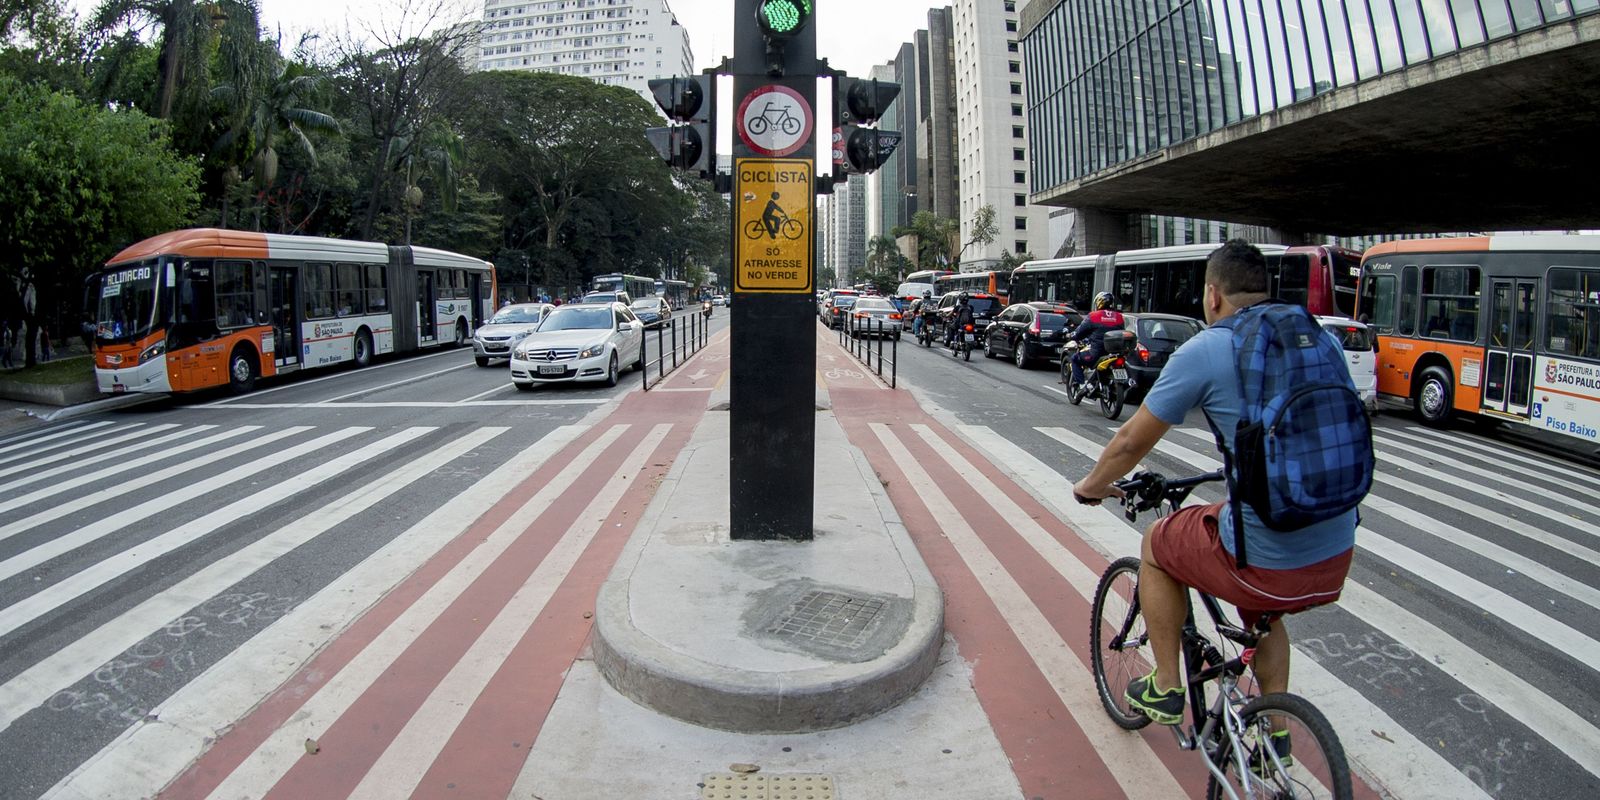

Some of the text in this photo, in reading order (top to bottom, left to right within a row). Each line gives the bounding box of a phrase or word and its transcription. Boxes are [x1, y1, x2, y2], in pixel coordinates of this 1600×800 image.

[741, 171, 807, 183] CICLISTA
[744, 259, 802, 268] ATRAVESSE
[1372, 262, 1392, 270] Viale
[107, 267, 151, 286] ACLINACAO
[747, 271, 798, 280] NO VERDE
[331, 327, 344, 335] PAULO
[1558, 363, 1593, 377] PREFEITURA
[1557, 371, 1574, 385] SÃO
[1546, 416, 1597, 438] Piso Baixo
